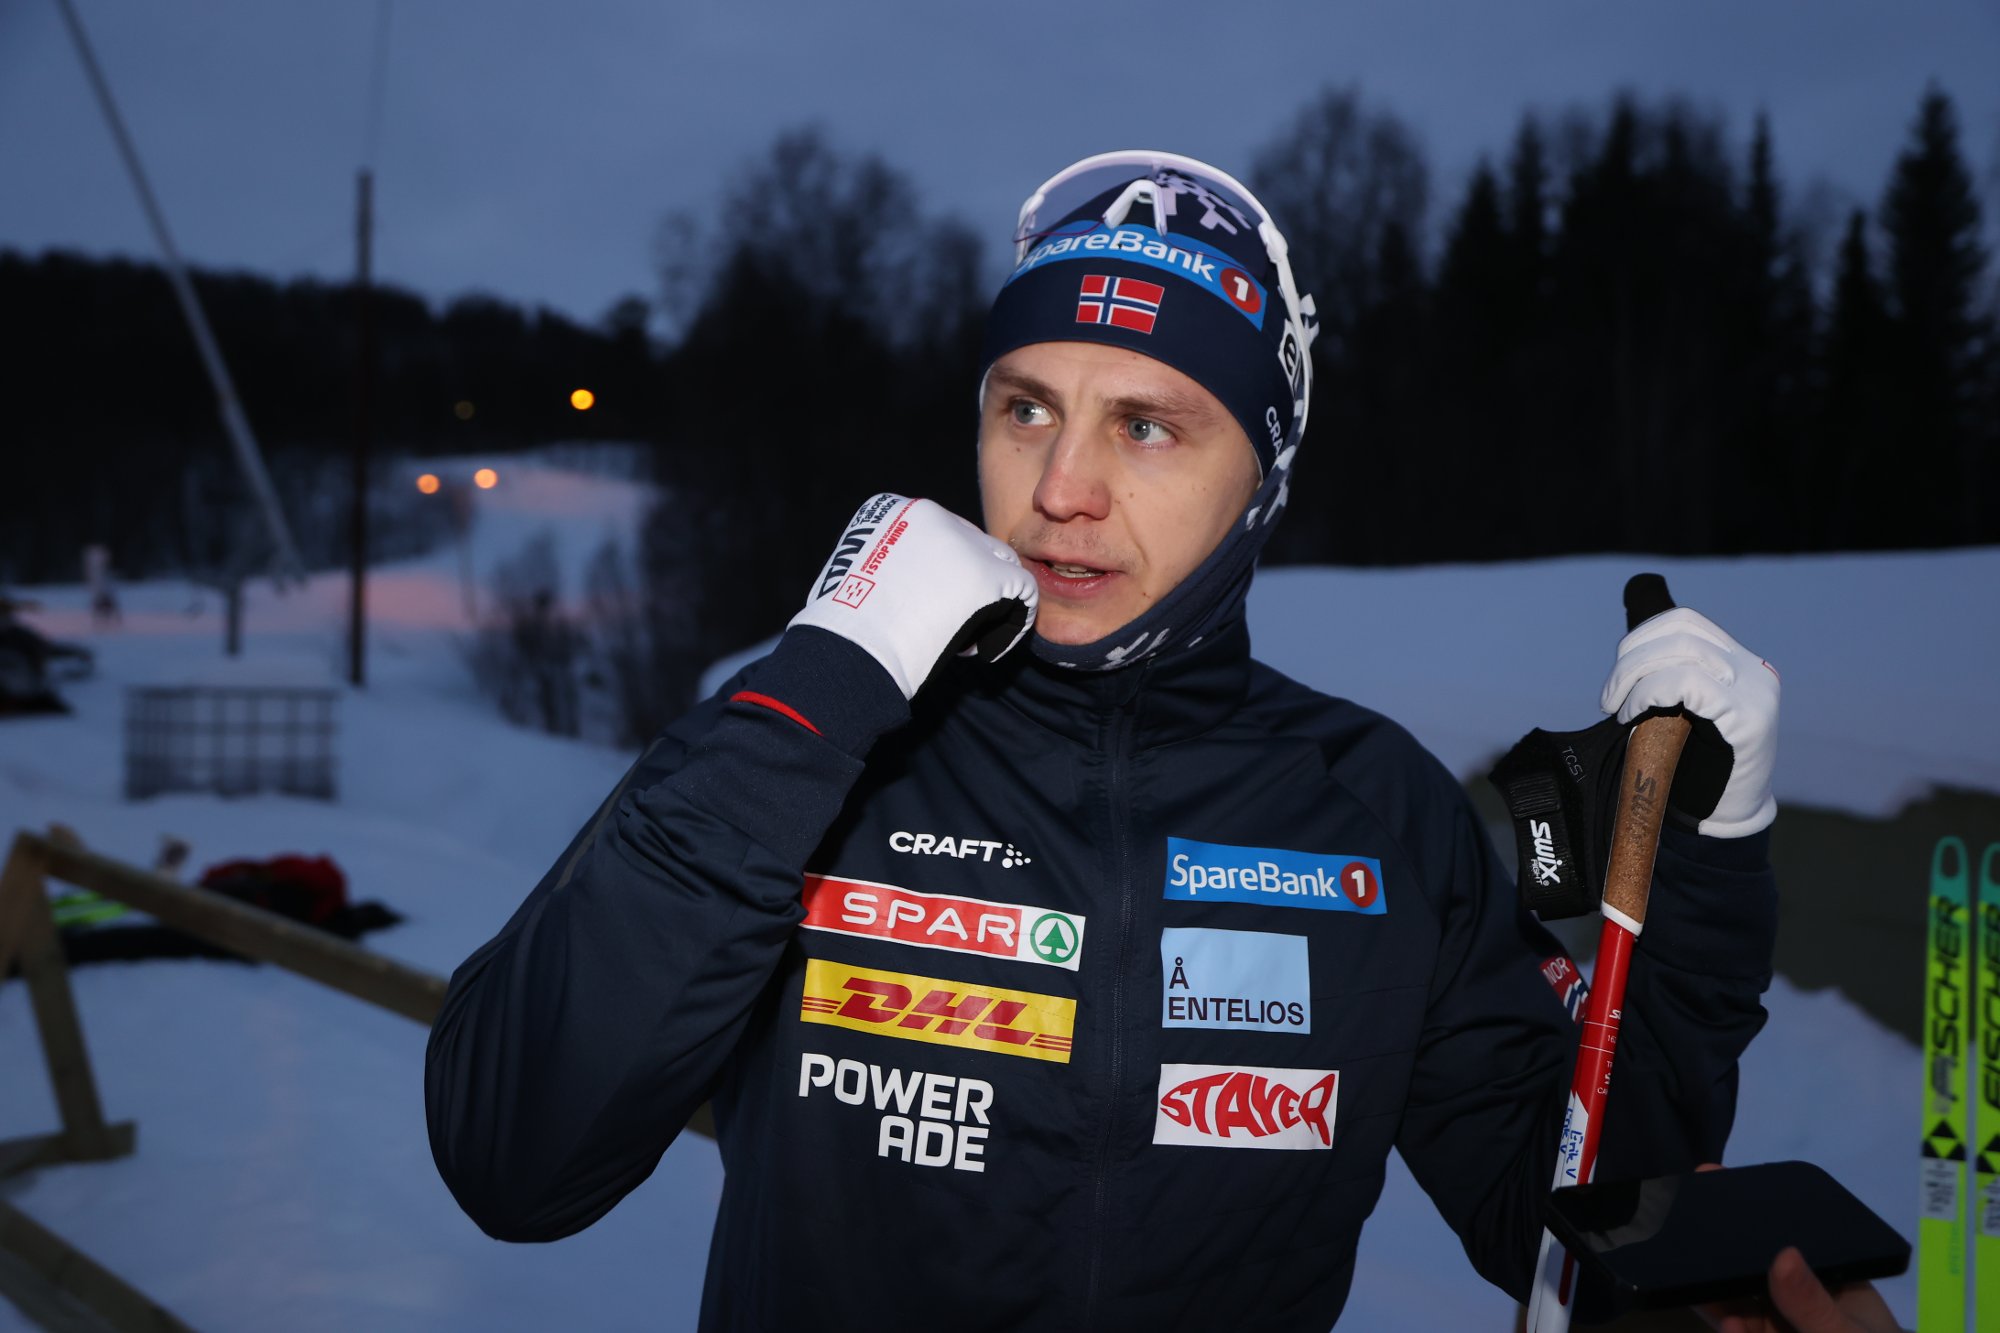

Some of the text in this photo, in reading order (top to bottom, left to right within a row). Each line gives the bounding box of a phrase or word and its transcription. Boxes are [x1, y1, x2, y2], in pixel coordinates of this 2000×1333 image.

[1232, 276, 1251, 302] 1
[870, 498, 901, 524] Motion
[868, 545, 890, 571] STOP
[886, 520, 909, 546] WIND
[889, 831, 1002, 862] CRAFT
[1170, 854, 1365, 898] SpareBank 1
[841, 891, 1016, 948] SPAR
[1169, 956, 1190, 990] Å
[1543, 956, 1571, 986] NOR
[836, 976, 1036, 1046] DHL
[1168, 996, 1305, 1026] ENTELIOS
[799, 1052, 994, 1125] POWER
[1160, 1072, 1335, 1147] STAYER
[878, 1115, 989, 1173] ADE
[1565, 1167, 1577, 1179] V
